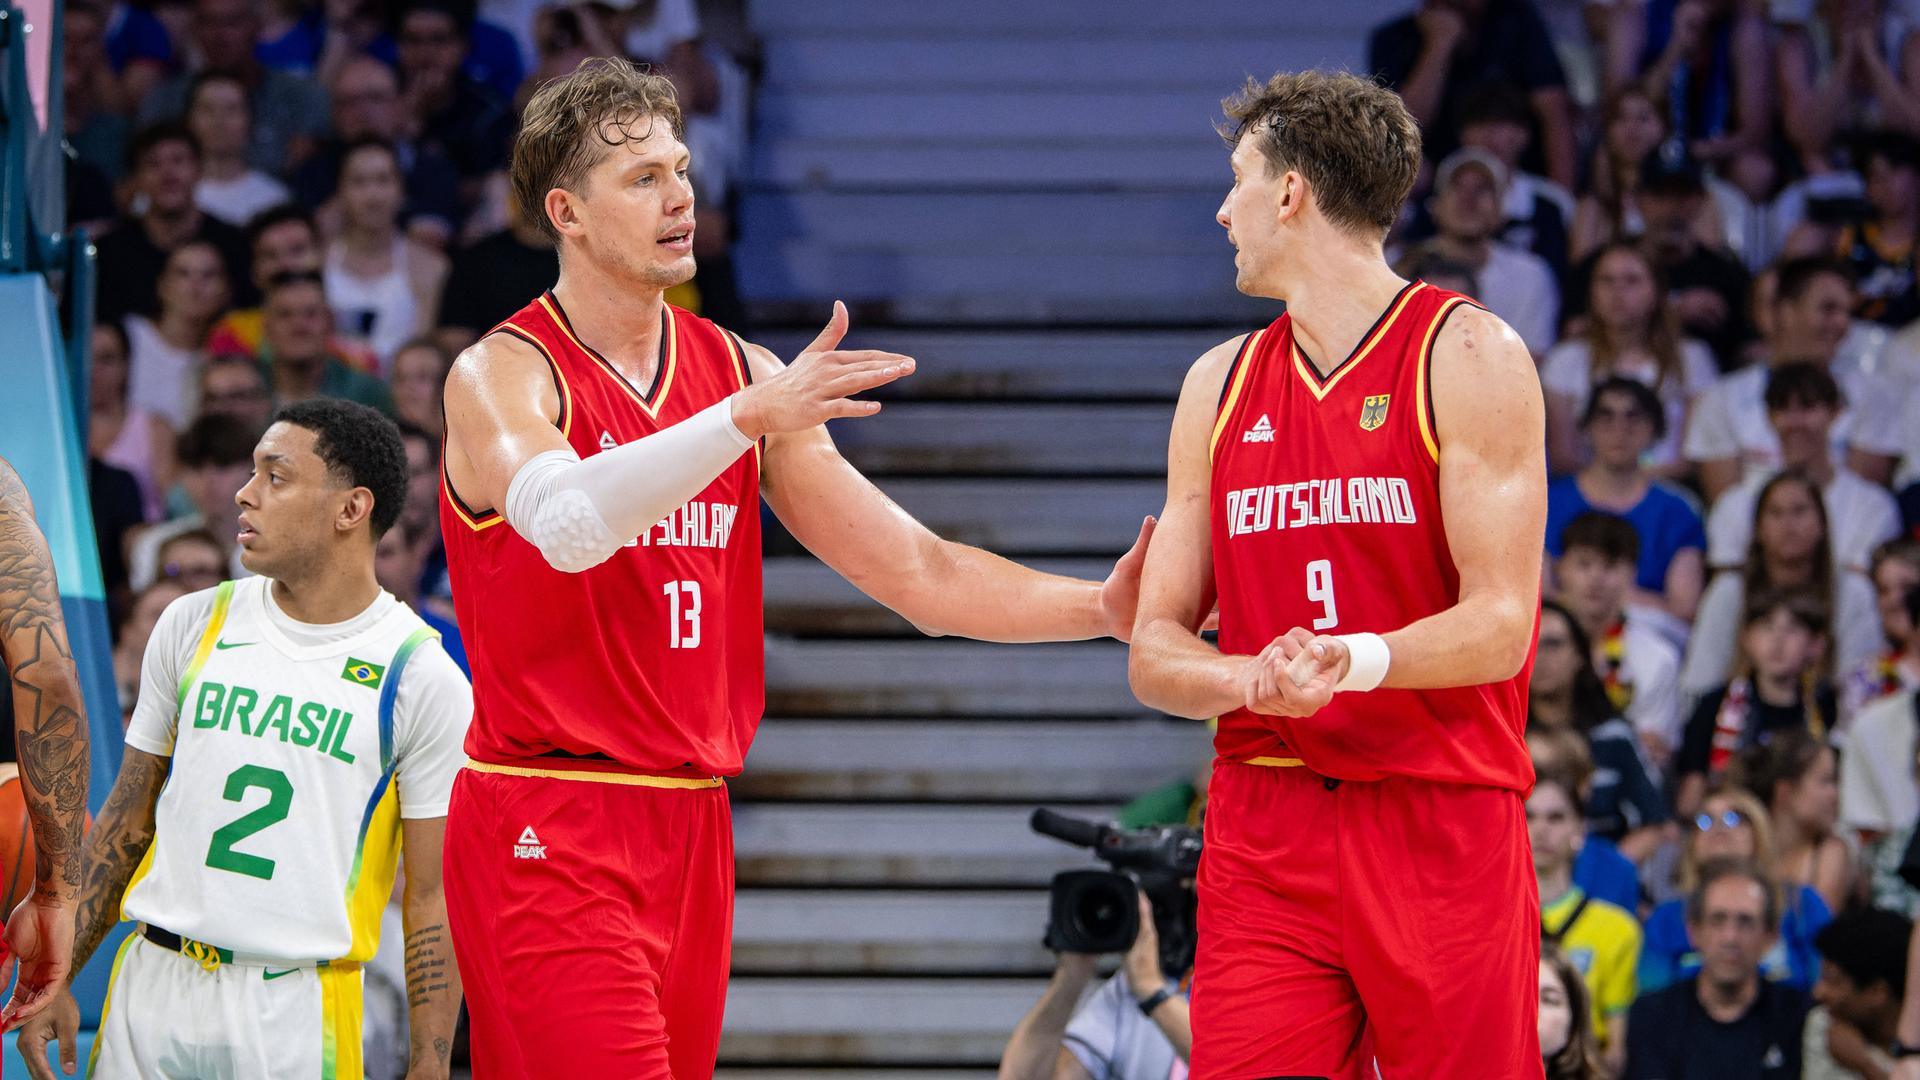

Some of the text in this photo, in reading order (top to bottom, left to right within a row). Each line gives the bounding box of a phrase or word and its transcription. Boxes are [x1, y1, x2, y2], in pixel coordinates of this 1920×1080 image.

[1242, 429, 1277, 443] PEAK
[1226, 477, 1417, 539] DEUTSCHLAND
[663, 580, 702, 649] 13
[1306, 559, 1338, 630] 9
[193, 681, 356, 765] BRASIL
[205, 763, 294, 881] 2
[513, 844, 548, 860] PEAK
